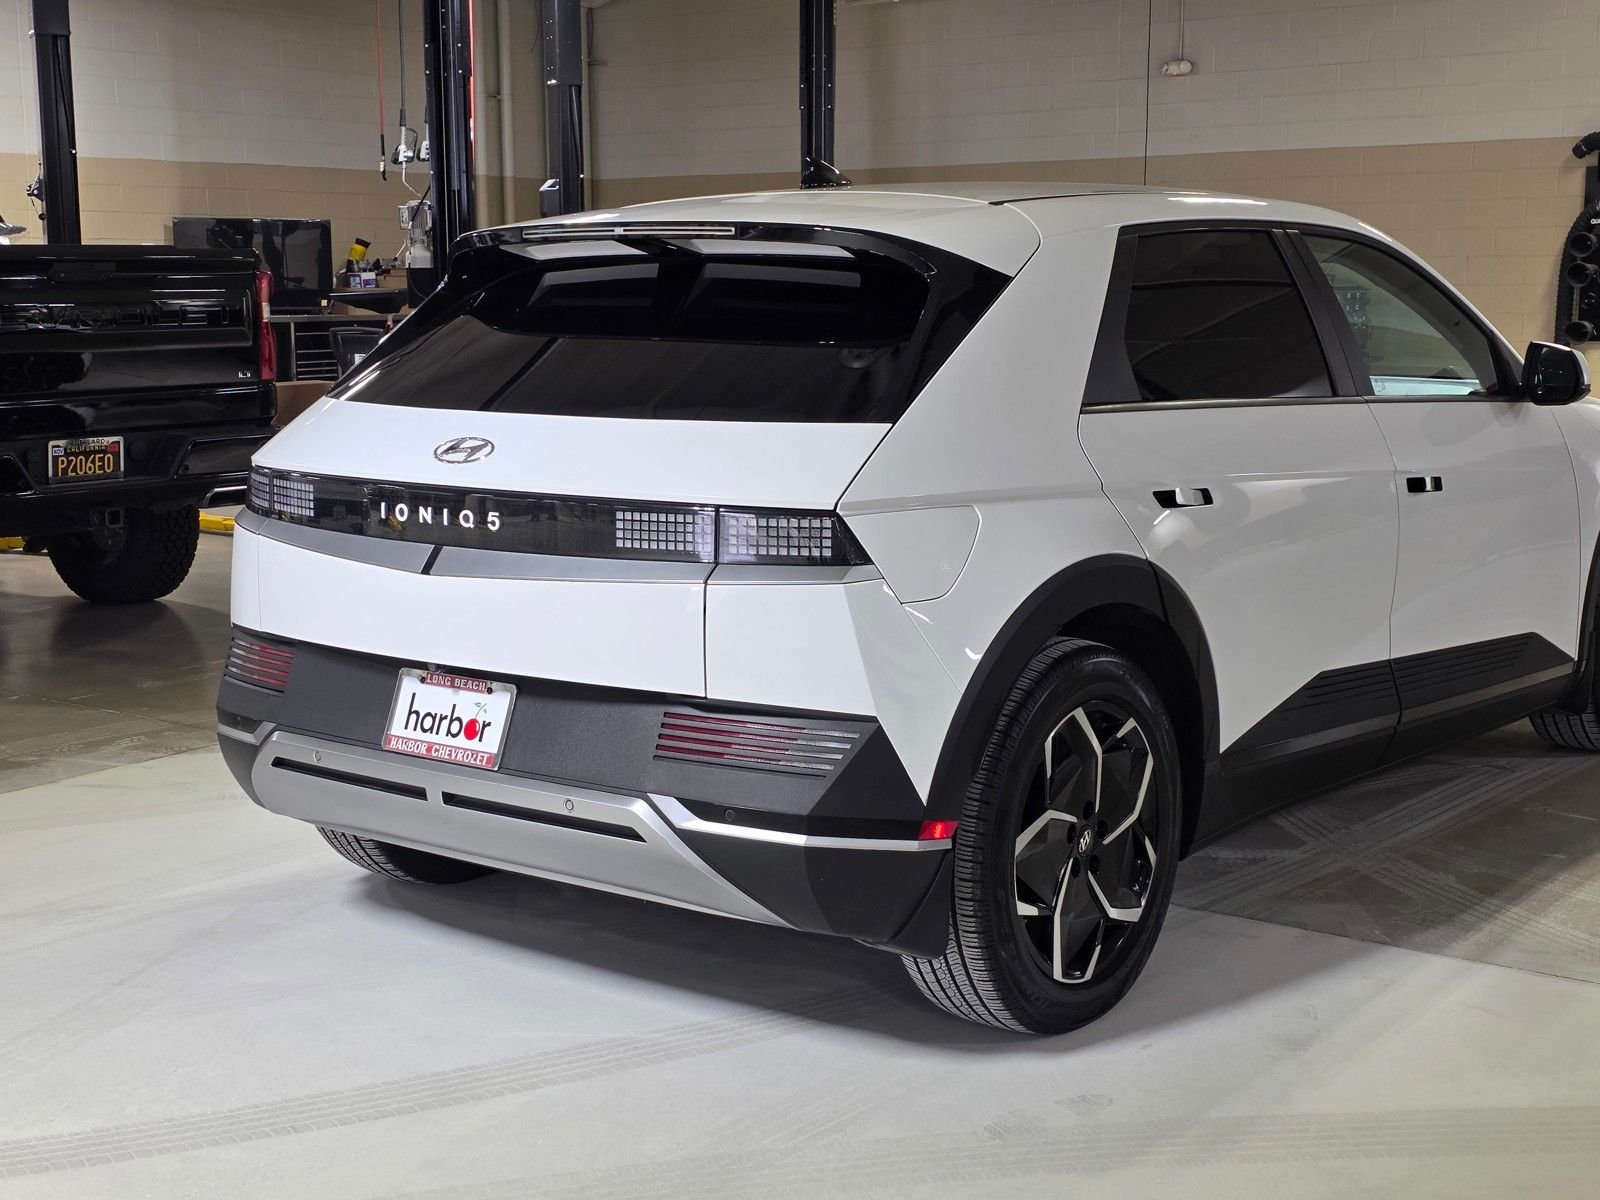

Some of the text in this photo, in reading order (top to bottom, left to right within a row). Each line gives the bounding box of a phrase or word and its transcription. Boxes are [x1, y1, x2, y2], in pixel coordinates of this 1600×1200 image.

[426, 674, 486, 692] LONG BEACH
[404, 692, 492, 742] harbor
[390, 737, 490, 766] HARBOR CHEVROLET
